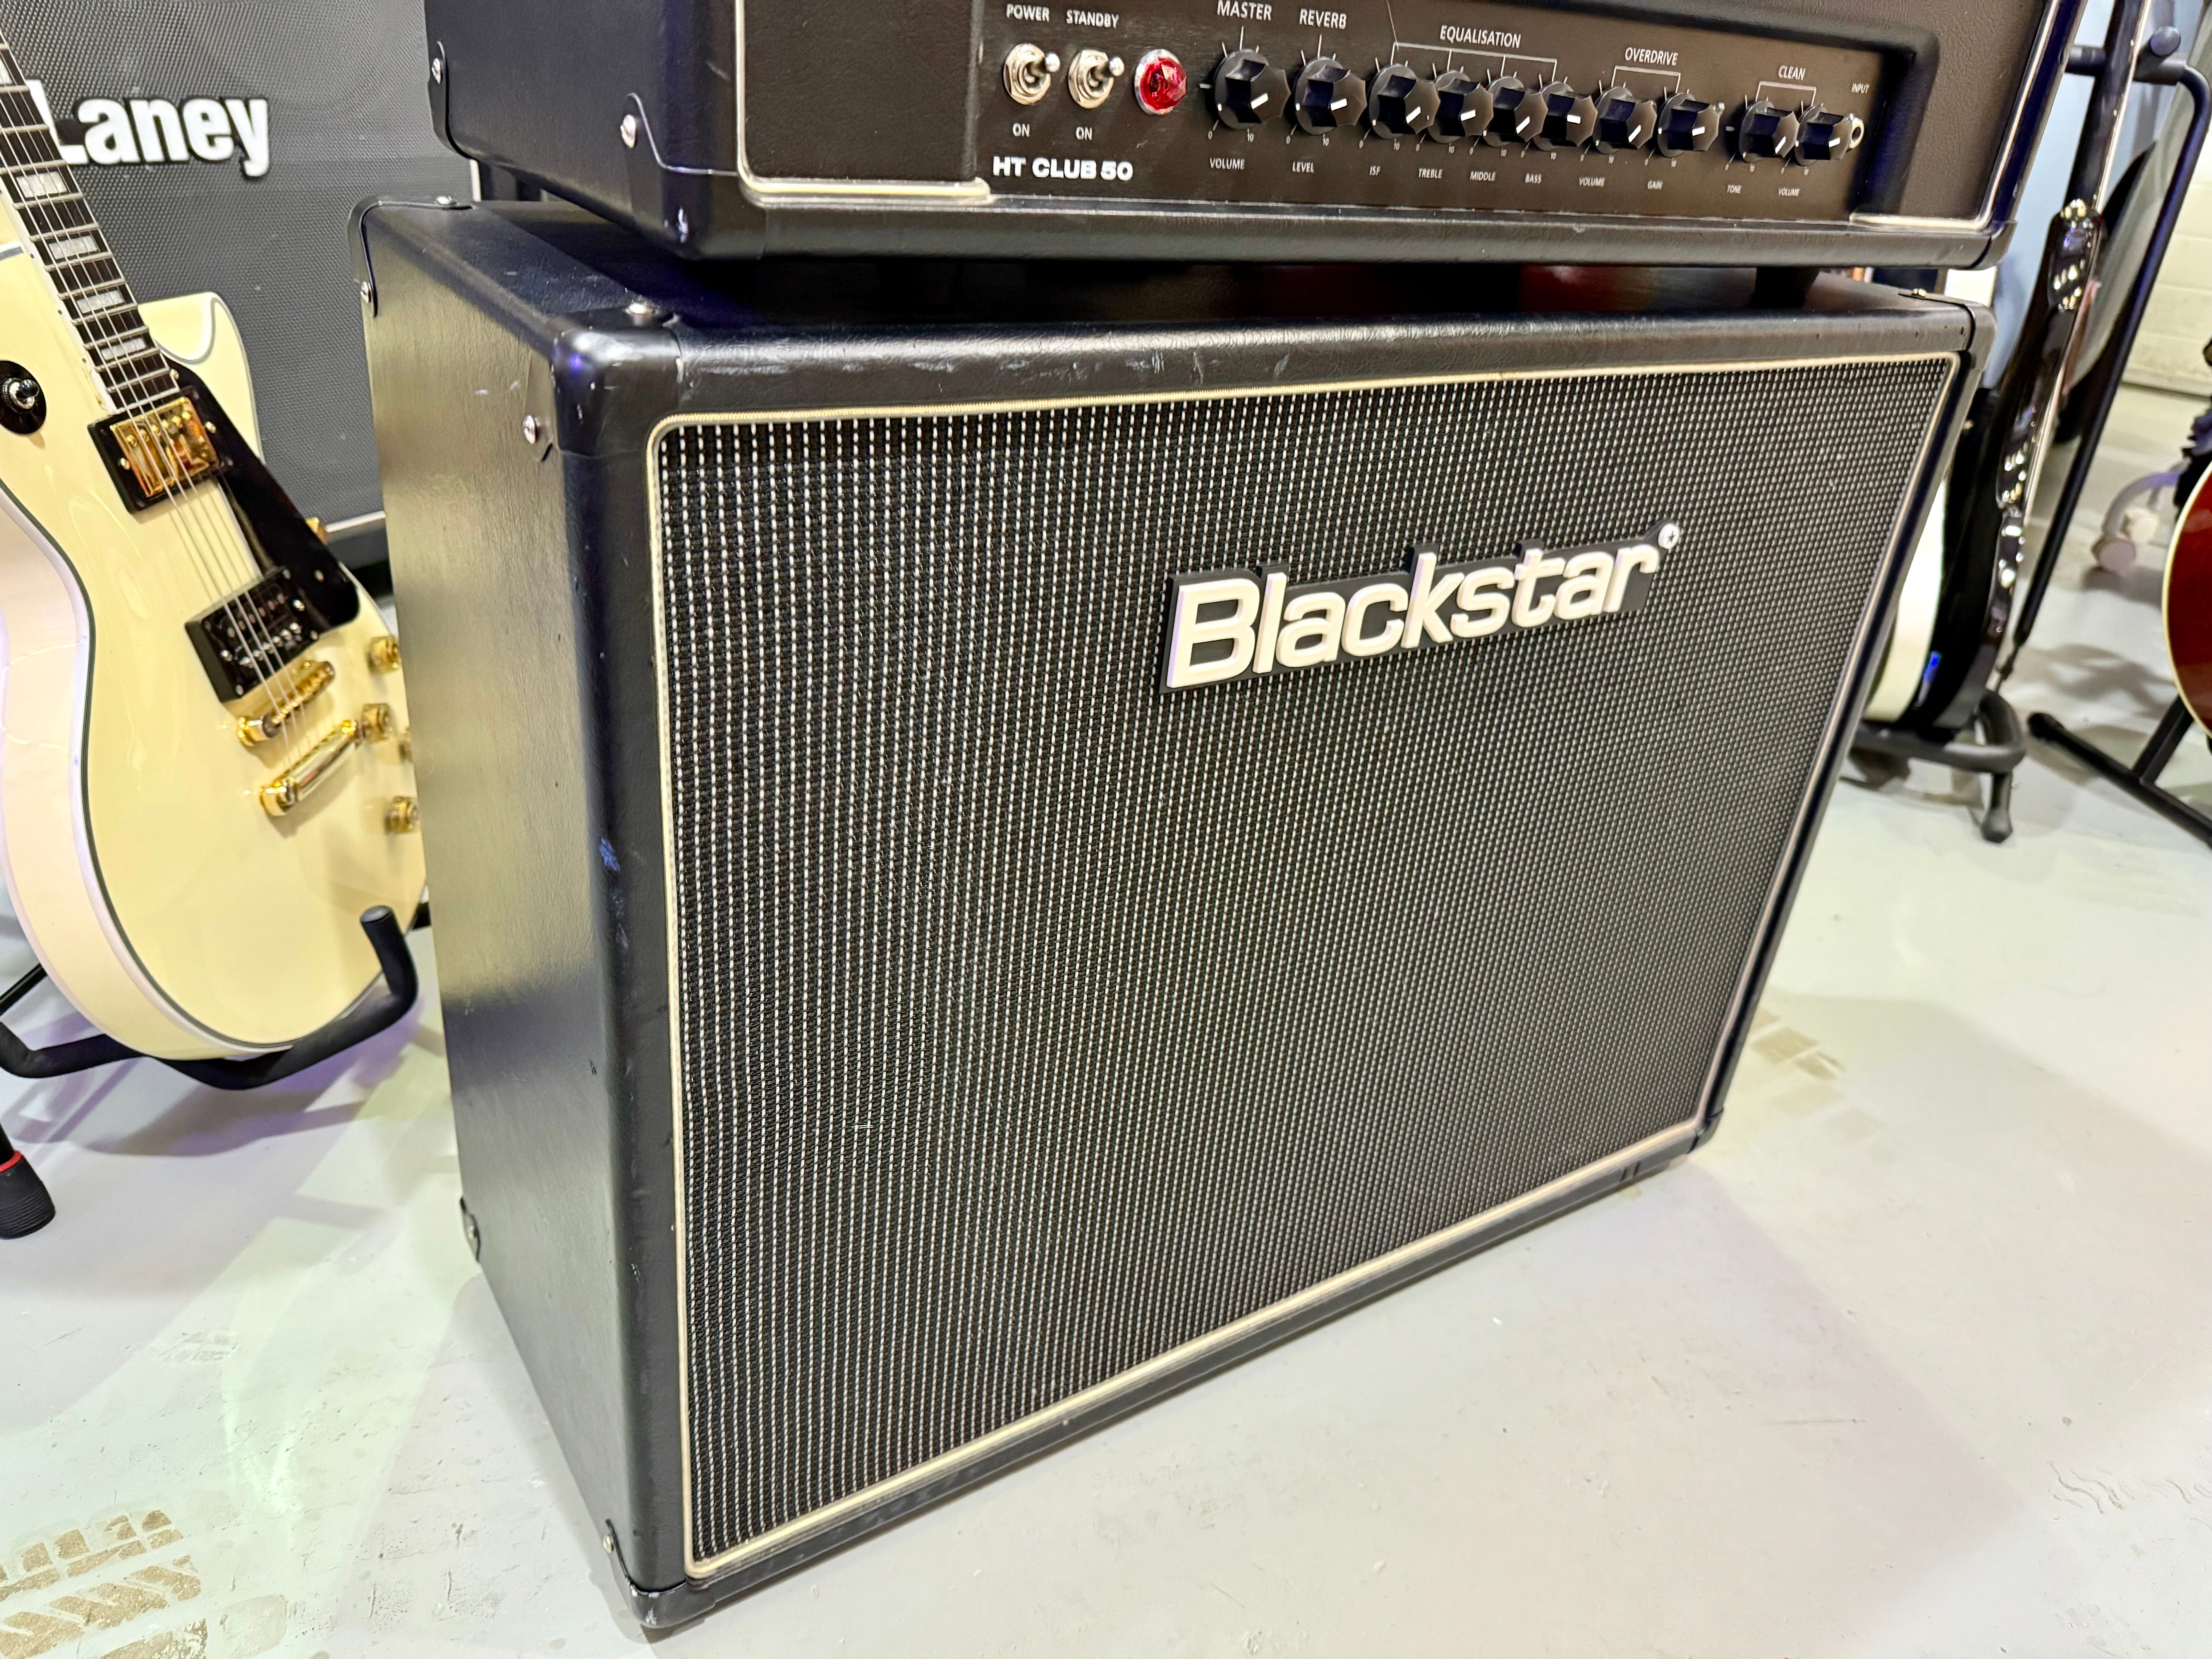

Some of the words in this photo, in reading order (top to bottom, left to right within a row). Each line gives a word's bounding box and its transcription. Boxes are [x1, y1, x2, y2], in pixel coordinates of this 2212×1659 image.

[1006, 3, 1049, 22] POWER
[1217, 0, 1272, 21] MASTER
[1066, 9, 1119, 29] STANDBY
[1299, 8, 1347, 29] REVERB
[1439, 24, 1521, 48] EQUALISATION
[1625, 46, 1678, 66] OVERDRIVE
[1778, 65, 1806, 81] CLEAN
[1851, 82, 1870, 94] INPUT
[1012, 123, 1030, 137] ON
[1075, 126, 1092, 140] ON
[993, 156, 1026, 177] HT
[1032, 157, 1097, 179] CLUB
[1100, 160, 1133, 181] 50
[1209, 157, 1245, 170] VOLUME
[1292, 161, 1314, 173] LEVEL
[1369, 165, 1381, 176] ISF
[1418, 167, 1443, 179] TREBLE
[1470, 171, 1496, 182] MIDDLE
[1524, 172, 1542, 184] BASS
[1579, 176, 1606, 187] VOLUME
[1647, 179, 1663, 190] GAIN
[1727, 184, 1742, 194] TONE
[1778, 187, 1800, 197] VOLUME
[1166, 543, 1660, 688] Blackstar
